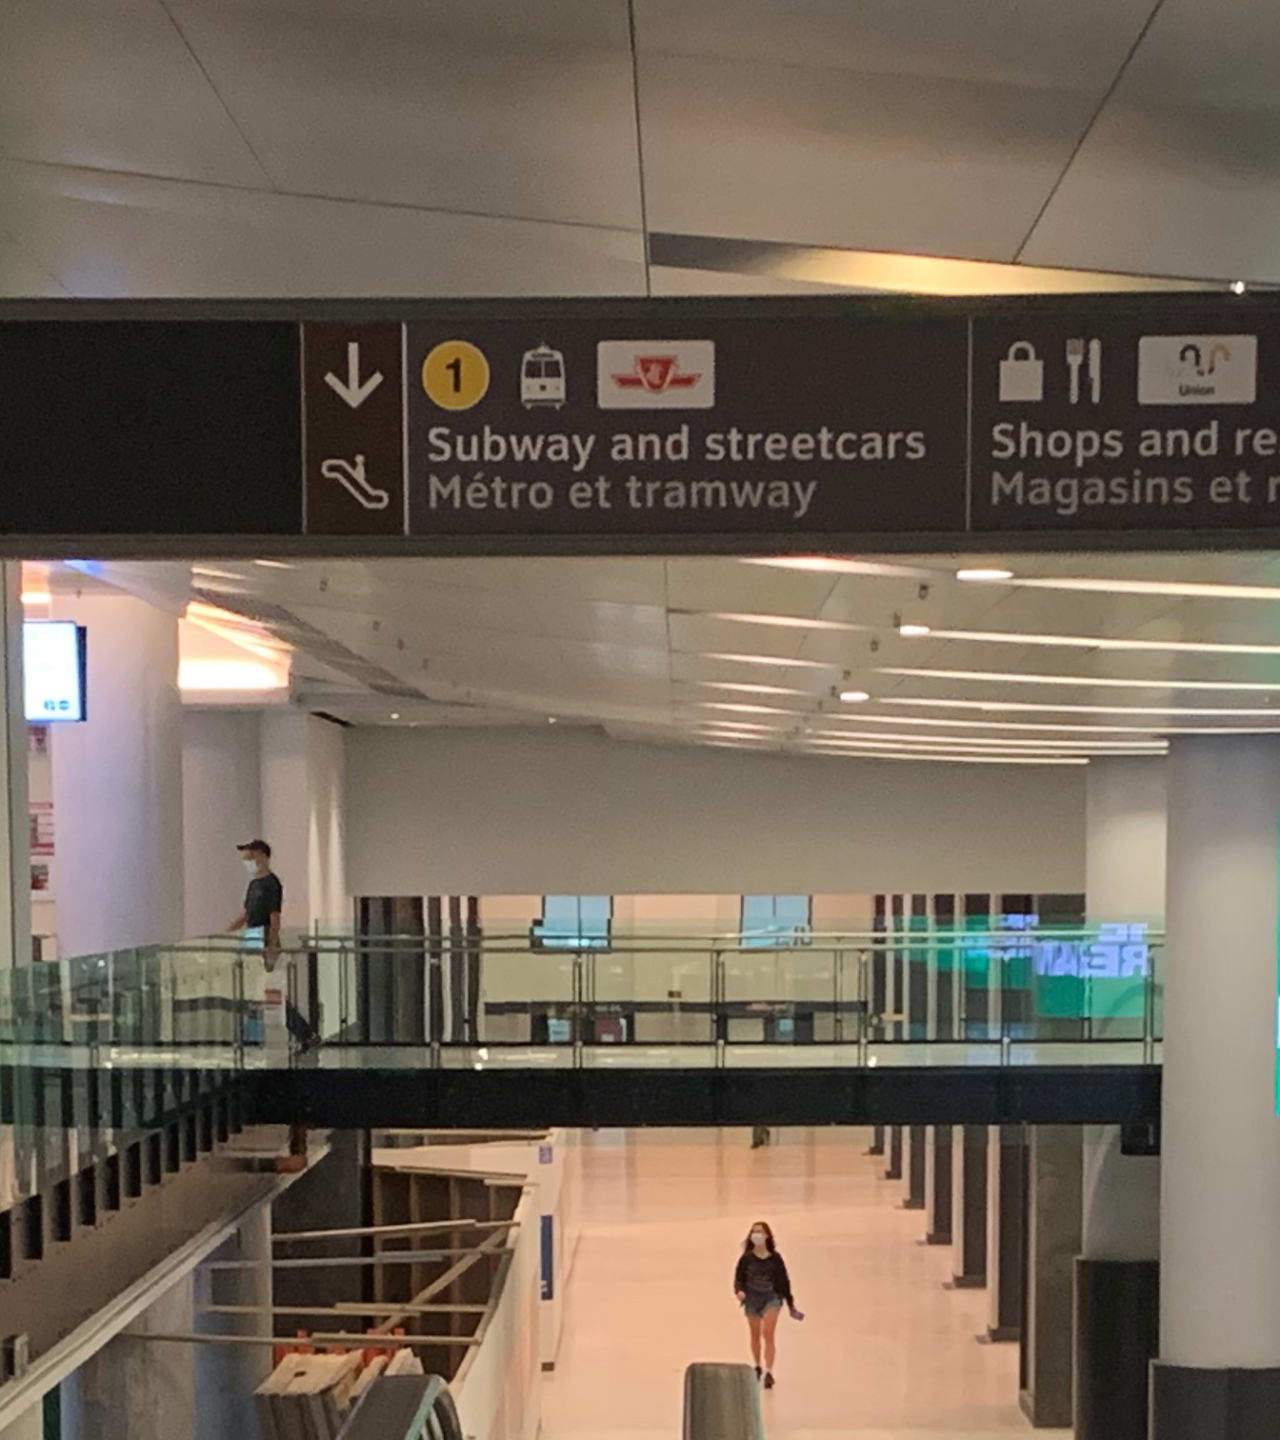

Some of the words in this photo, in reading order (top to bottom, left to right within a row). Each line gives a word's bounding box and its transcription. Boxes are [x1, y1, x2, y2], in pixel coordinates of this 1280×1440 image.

[445, 358, 463, 393] 1
[1178, 383, 1215, 397] Union
[428, 426, 595, 471] Subway
[611, 426, 689, 461] and
[705, 425, 925, 460] streetcars
[992, 422, 1124, 466] Shops
[1139, 423, 1219, 456] and
[429, 473, 553, 509] Métro
[569, 478, 611, 509] et
[624, 478, 816, 518] tramway
[992, 470, 1193, 515] Magasins
[1210, 473, 1251, 504] et
